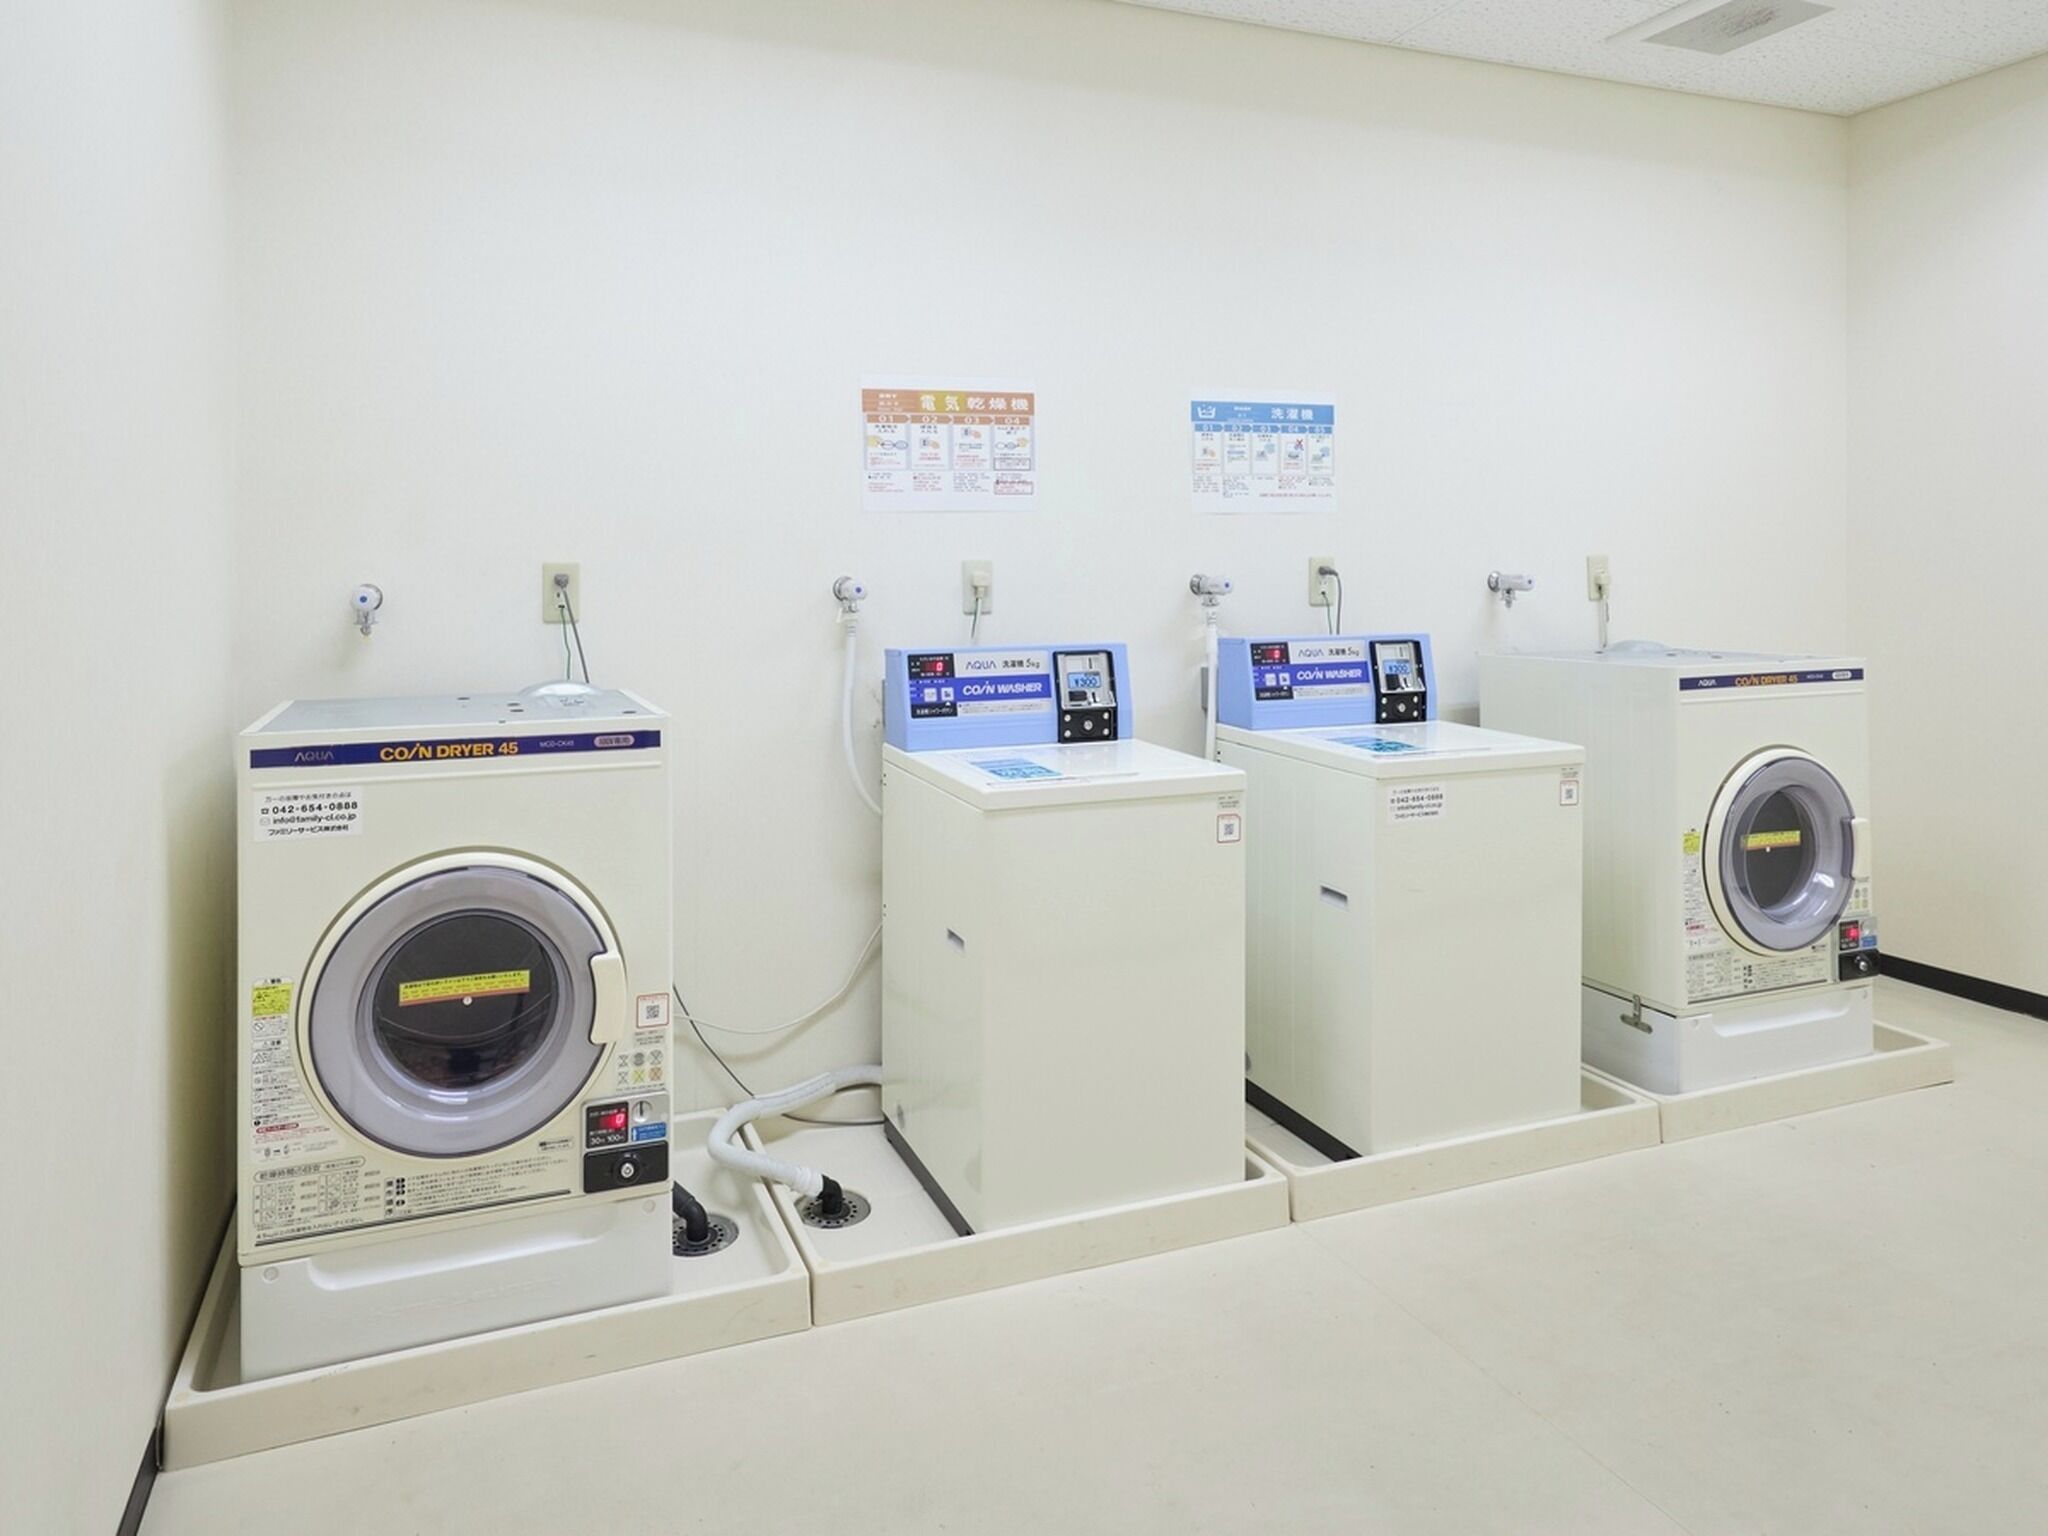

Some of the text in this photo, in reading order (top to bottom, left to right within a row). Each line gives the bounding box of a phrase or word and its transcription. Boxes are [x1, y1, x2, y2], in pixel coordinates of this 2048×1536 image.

[920, 394, 1029, 411] 電気乾燥機
[922, 415, 938, 423] 02
[1271, 408, 1314, 420] 洗濯機
[1298, 648, 1325, 657] AQUA
[966, 658, 1041, 670] AQUA 洗濯機 5kg
[1325, 669, 1362, 679] WASHER
[1761, 675, 1787, 685] DRYER
[997, 682, 1042, 694] WASHER
[1072, 677, 1098, 688] ¥300
[1698, 679, 1718, 687] AQUA
[437, 743, 494, 758] DRYER
[499, 742, 519, 754] 45
[295, 751, 334, 763] AQUA
[616, 1112, 625, 1124] 0
